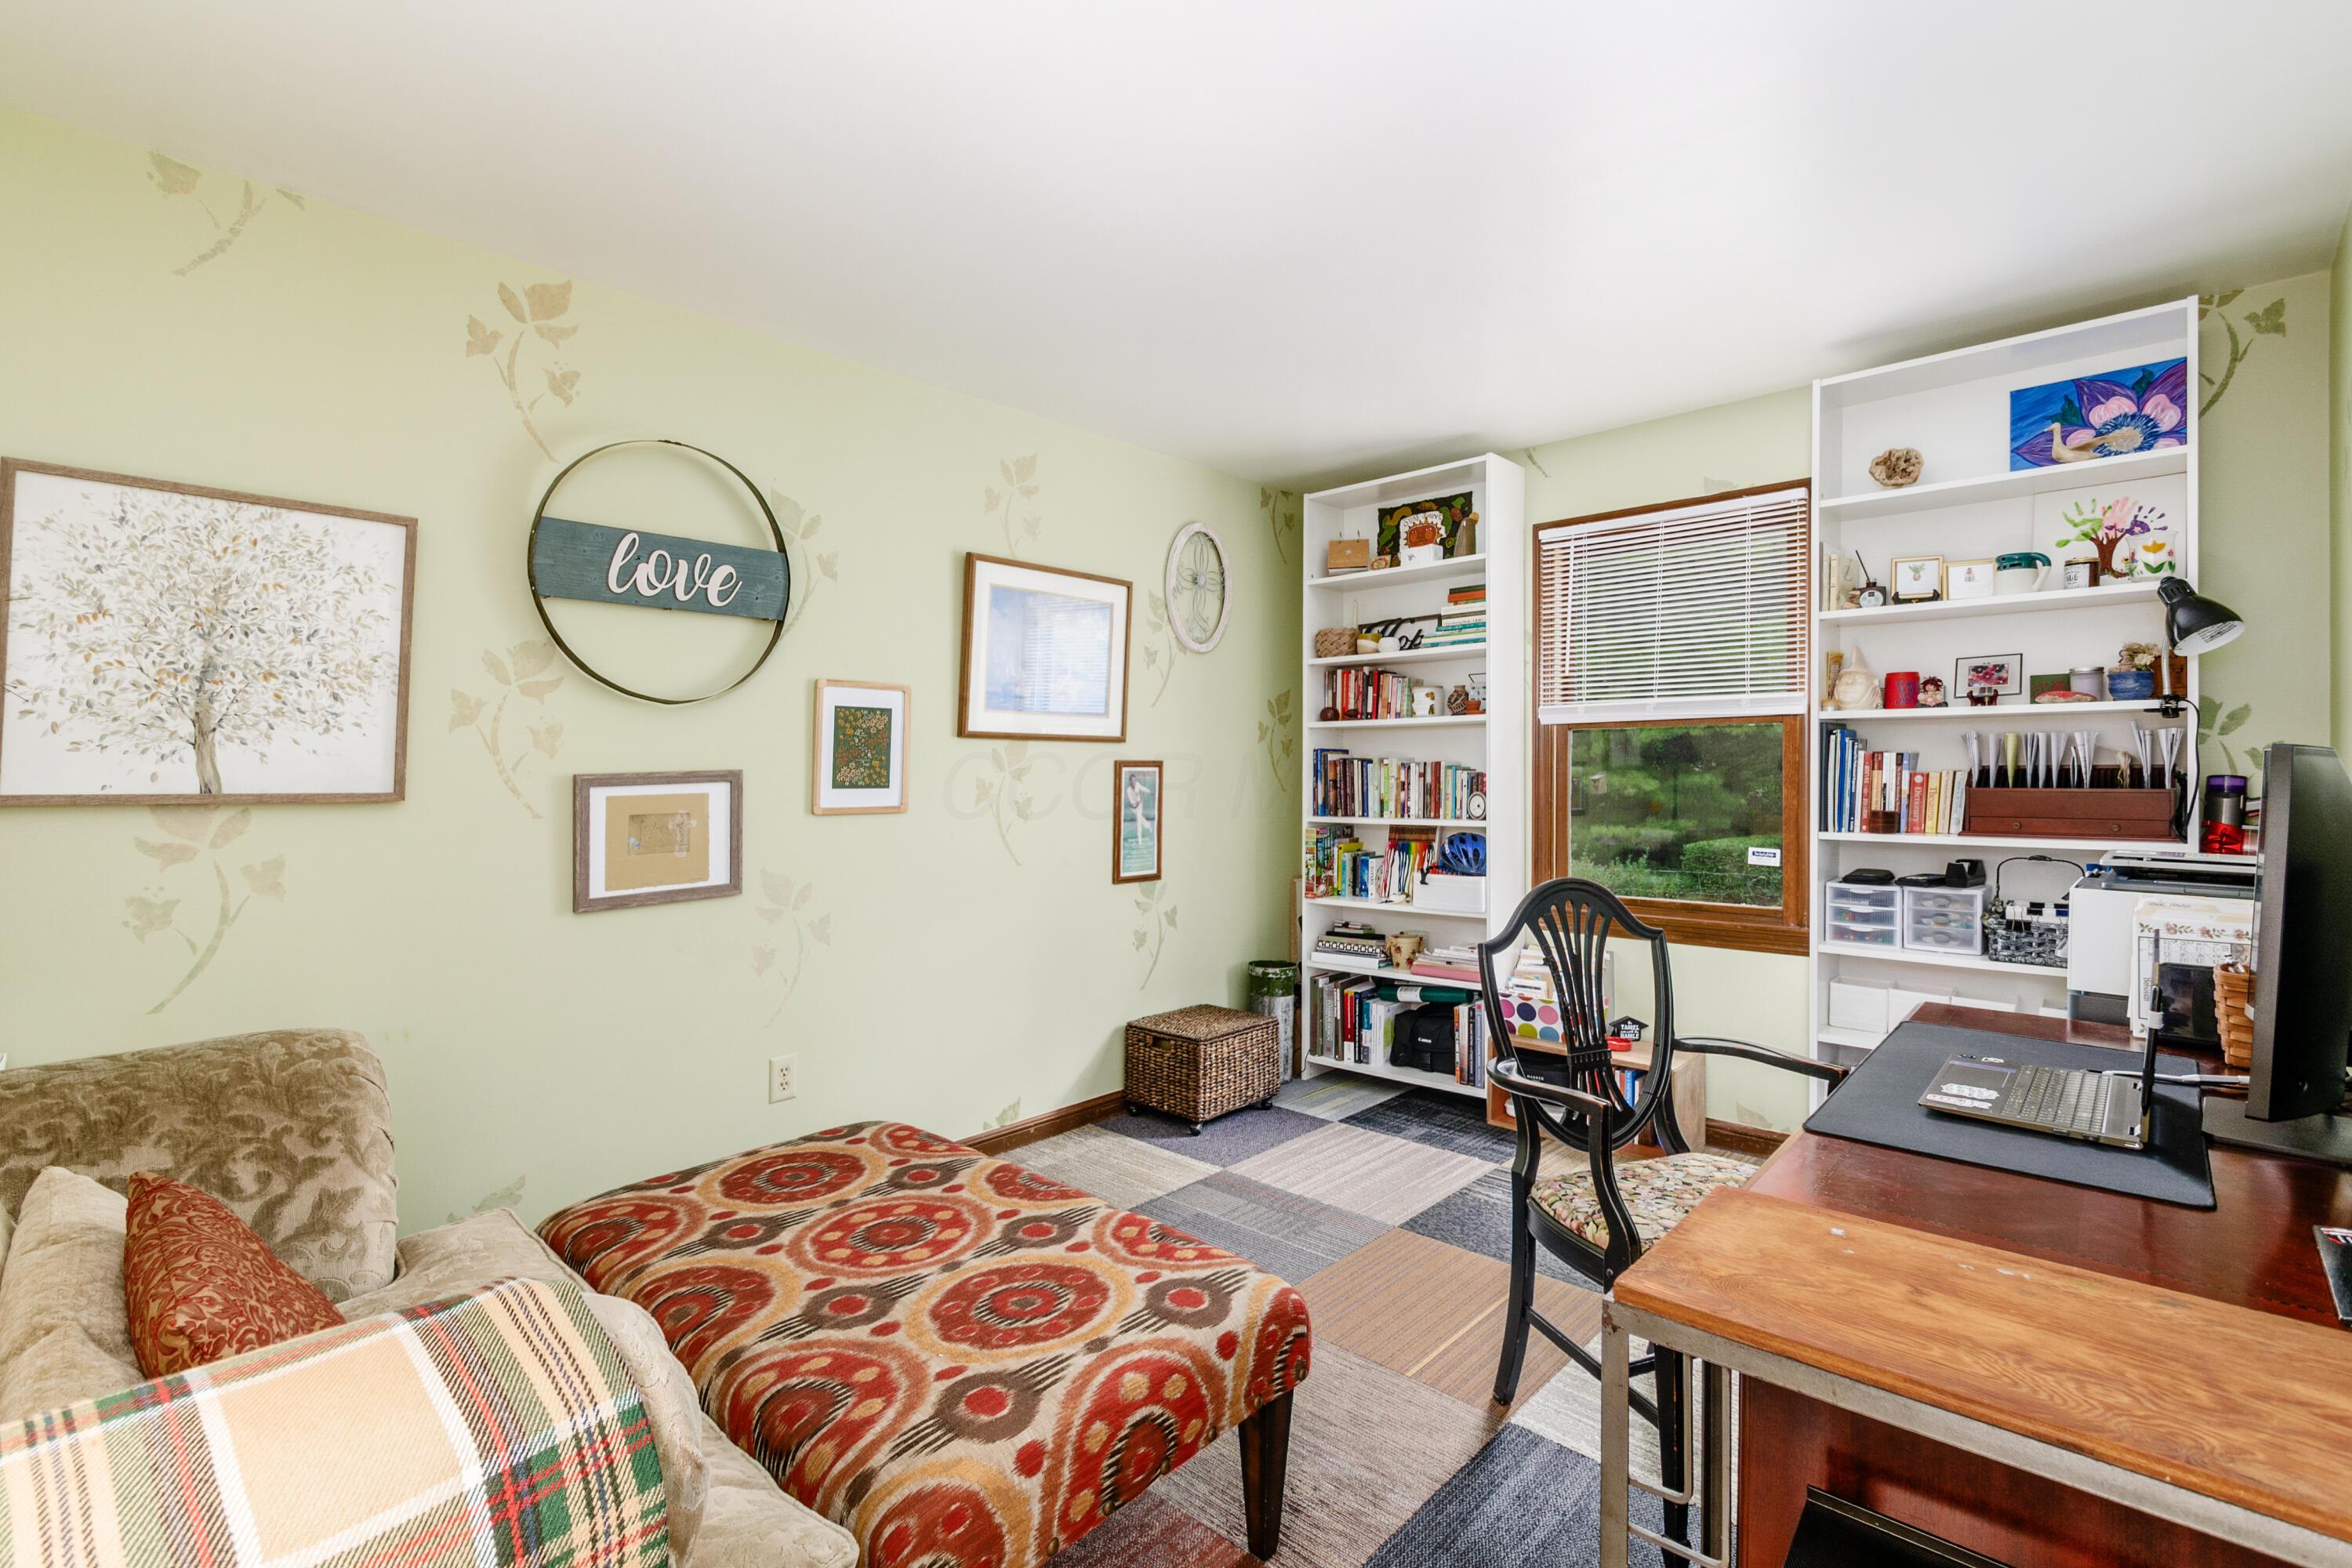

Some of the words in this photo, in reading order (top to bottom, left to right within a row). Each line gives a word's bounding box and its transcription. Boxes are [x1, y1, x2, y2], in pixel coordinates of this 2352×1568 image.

[608, 532, 742, 608] love
[1913, 786, 1922, 822] Dictionary
[1928, 786, 1937, 821] Thesaurus
